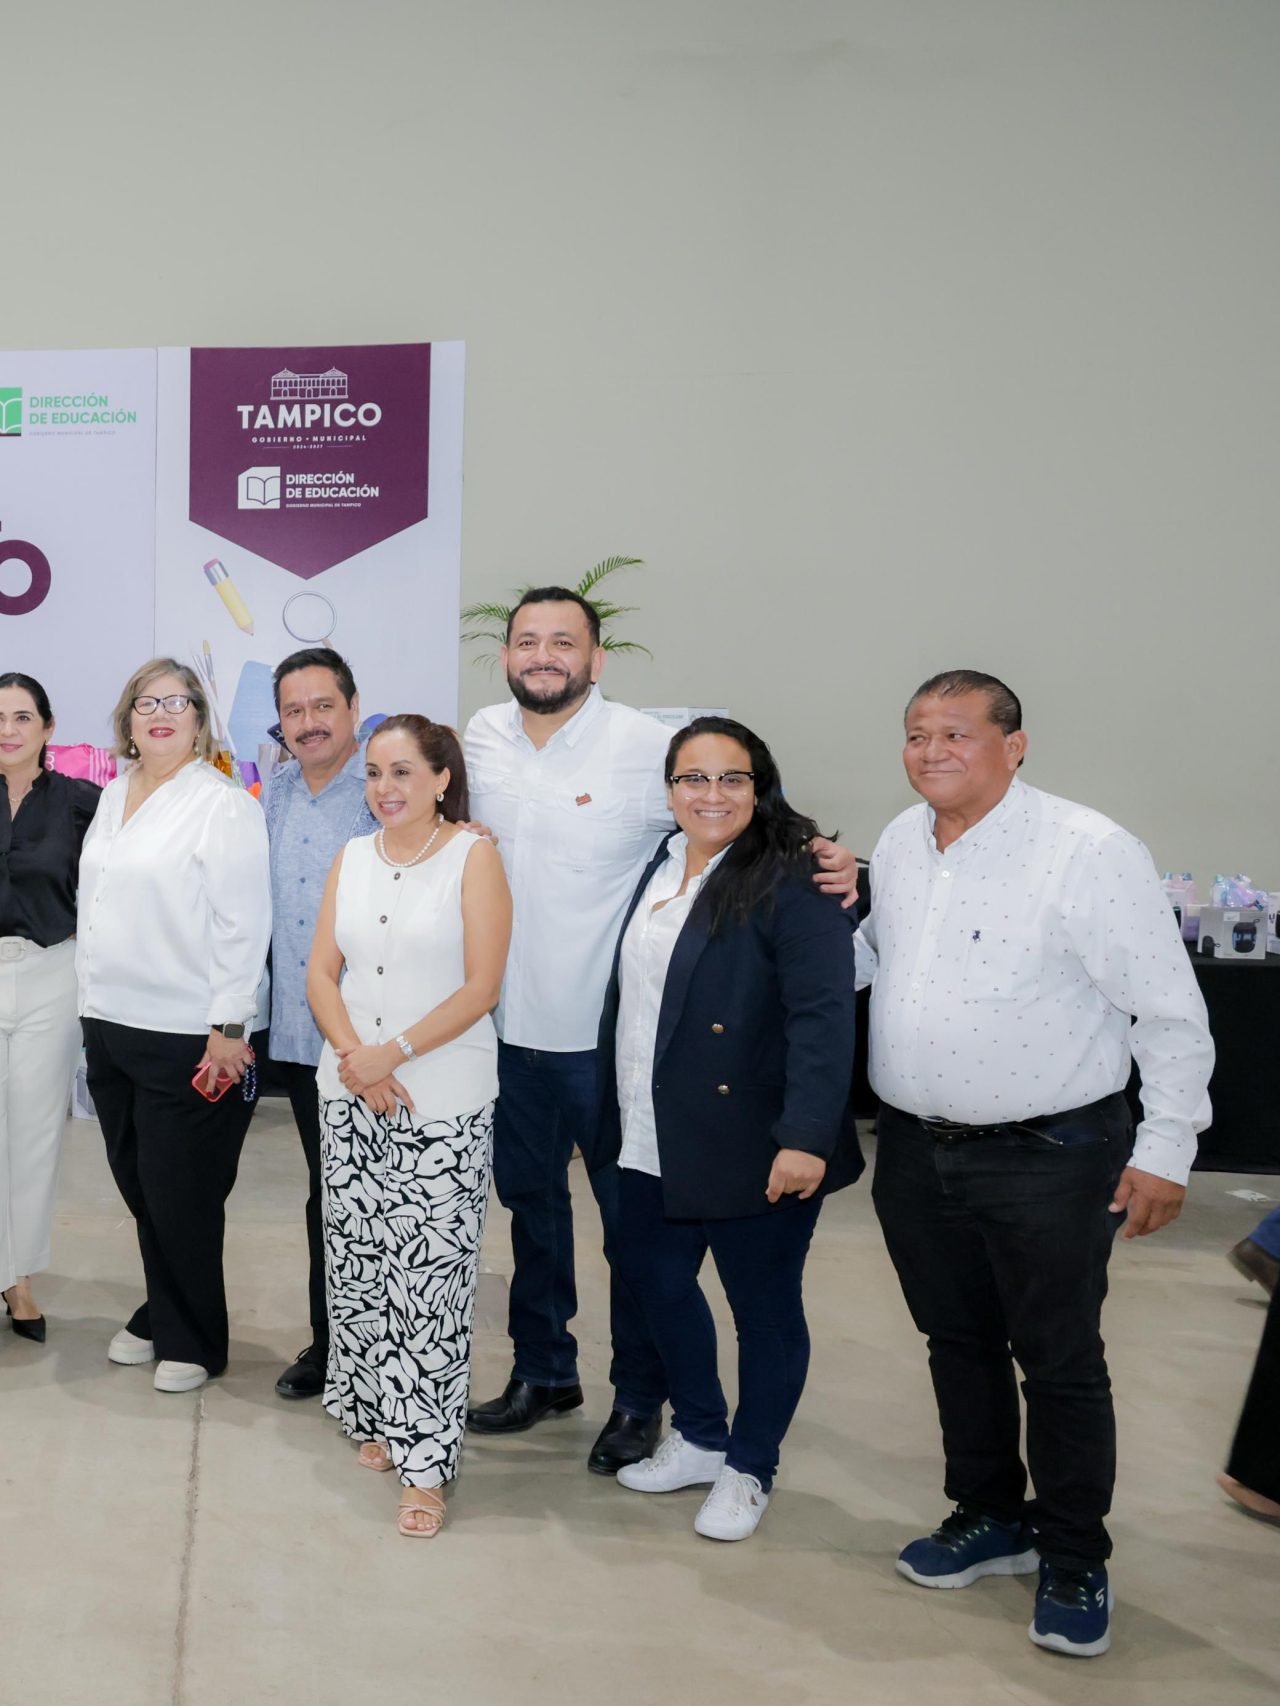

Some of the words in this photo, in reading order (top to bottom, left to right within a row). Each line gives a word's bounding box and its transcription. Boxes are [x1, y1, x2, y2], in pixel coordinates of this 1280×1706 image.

[29, 392, 109, 408] DIRECCIÓN
[29, 412, 47, 425] DE
[51, 407, 137, 425] EDUCACIÓN
[237, 402, 382, 429] TAMPICO
[251, 435, 303, 443] GOBIERNO
[312, 434, 367, 442] MUNICIPAL
[286, 471, 355, 485] DIRECCIÓN
[285, 487, 302, 499] DE
[304, 483, 380, 498] EDUCACIÓN
